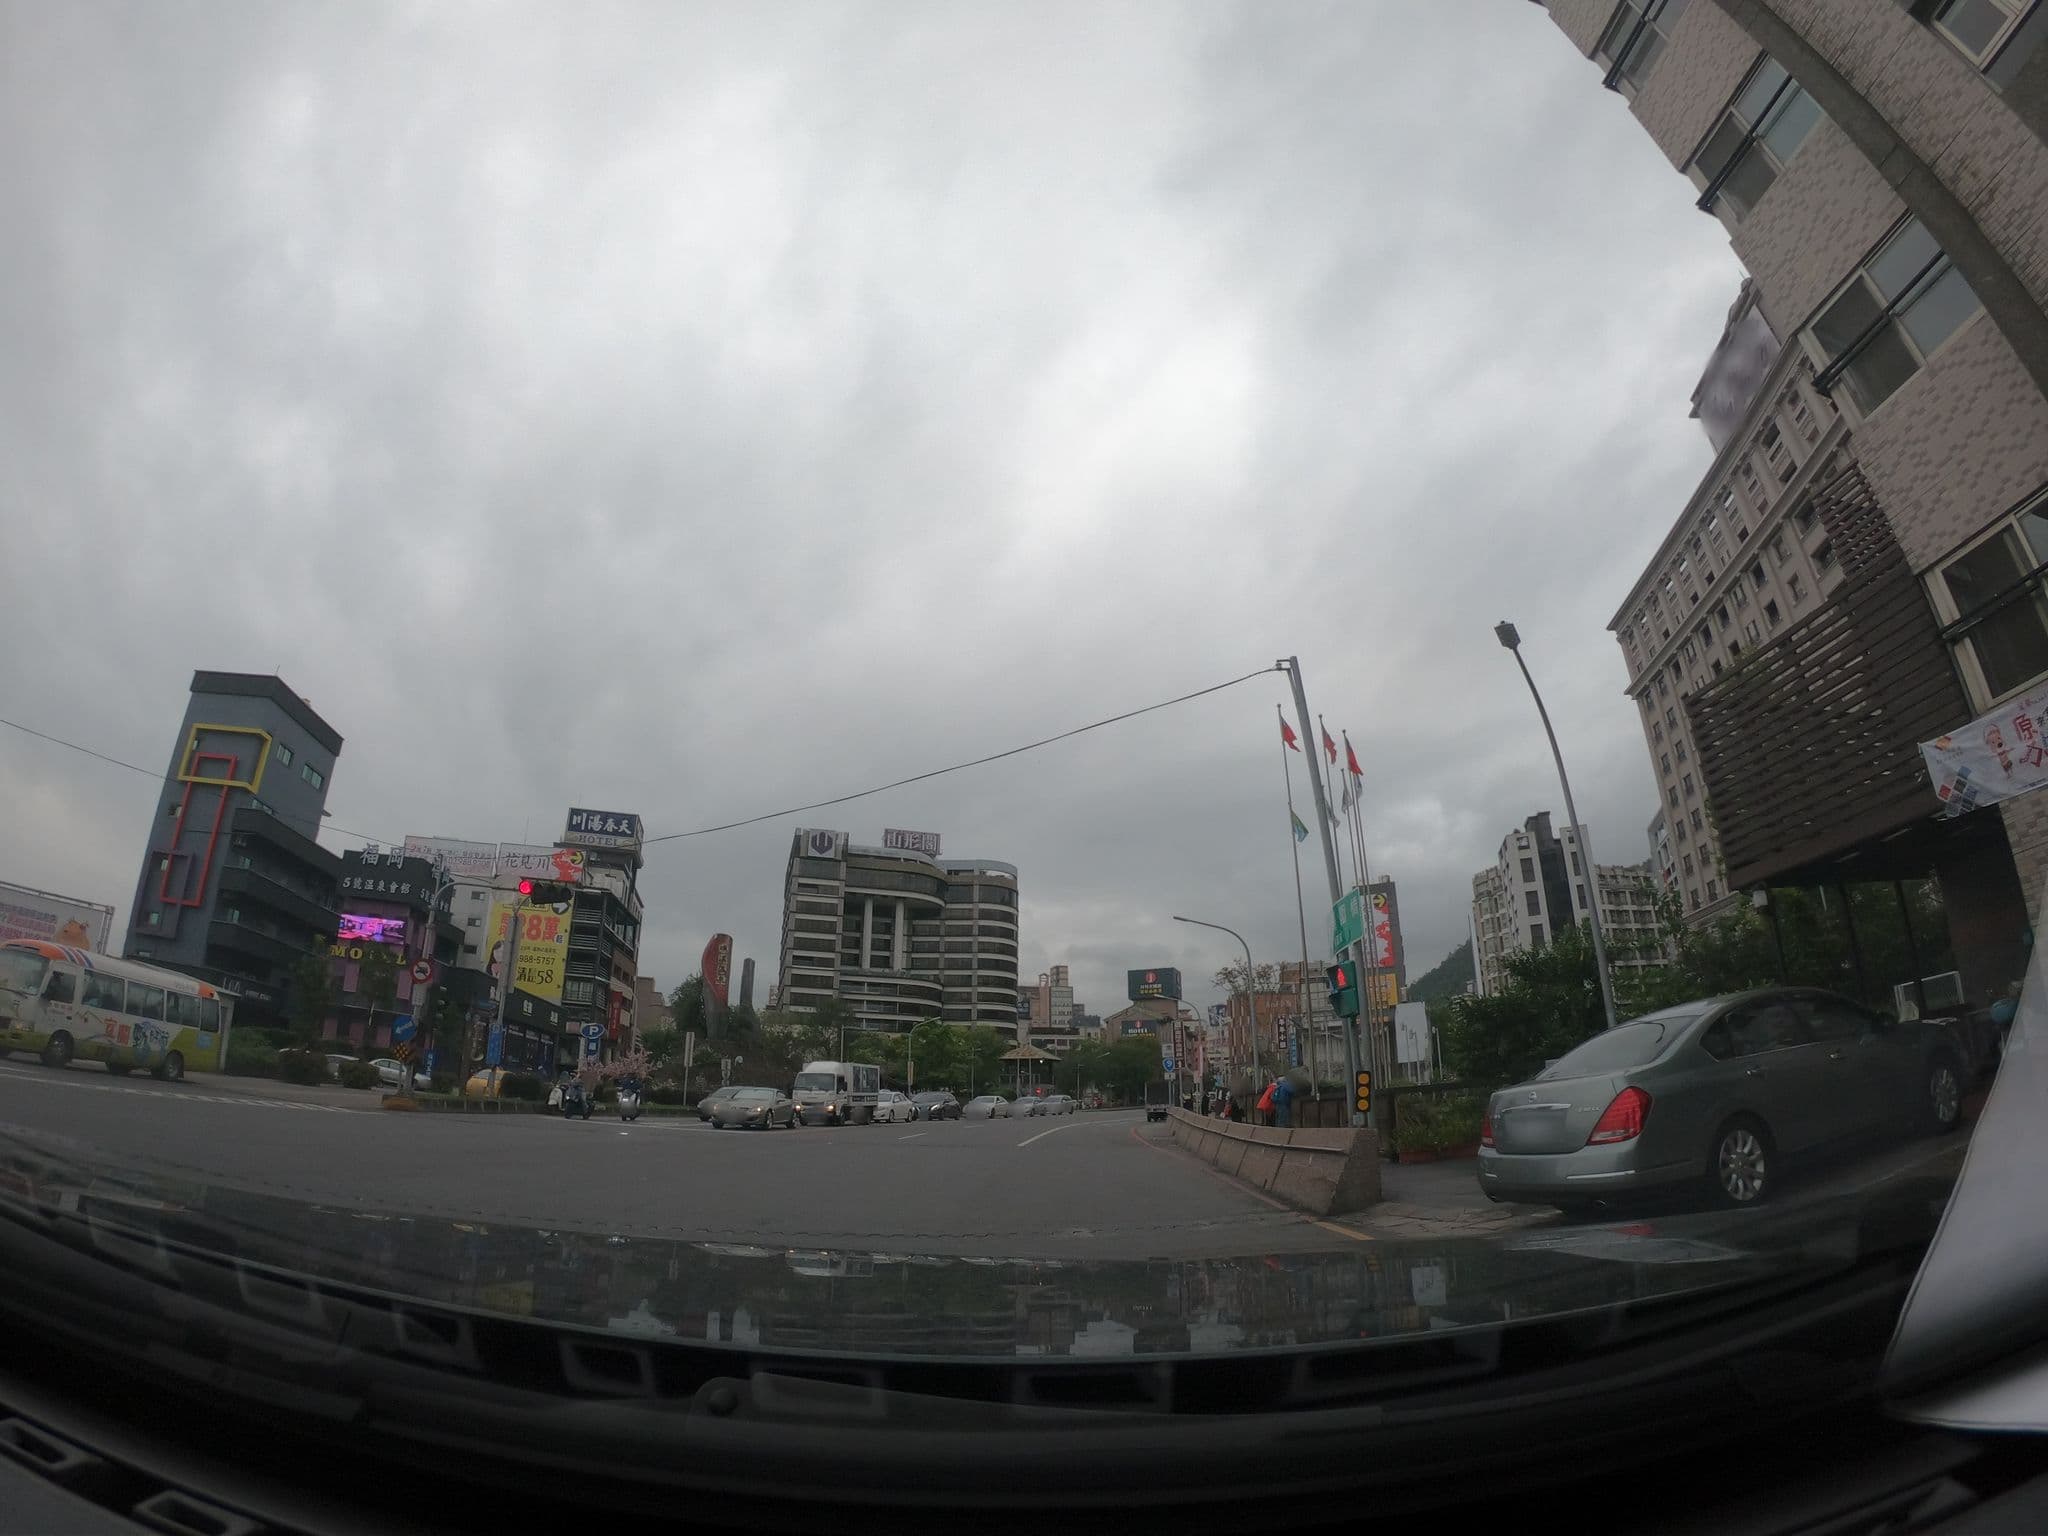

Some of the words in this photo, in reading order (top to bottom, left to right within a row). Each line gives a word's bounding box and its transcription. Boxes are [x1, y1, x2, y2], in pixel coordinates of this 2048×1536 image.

[578, 834, 618, 847] HOTEL
[360, 843, 404, 869] 福岡
[330, 944, 406, 965] MOL
[589, 1026, 600, 1036] P
